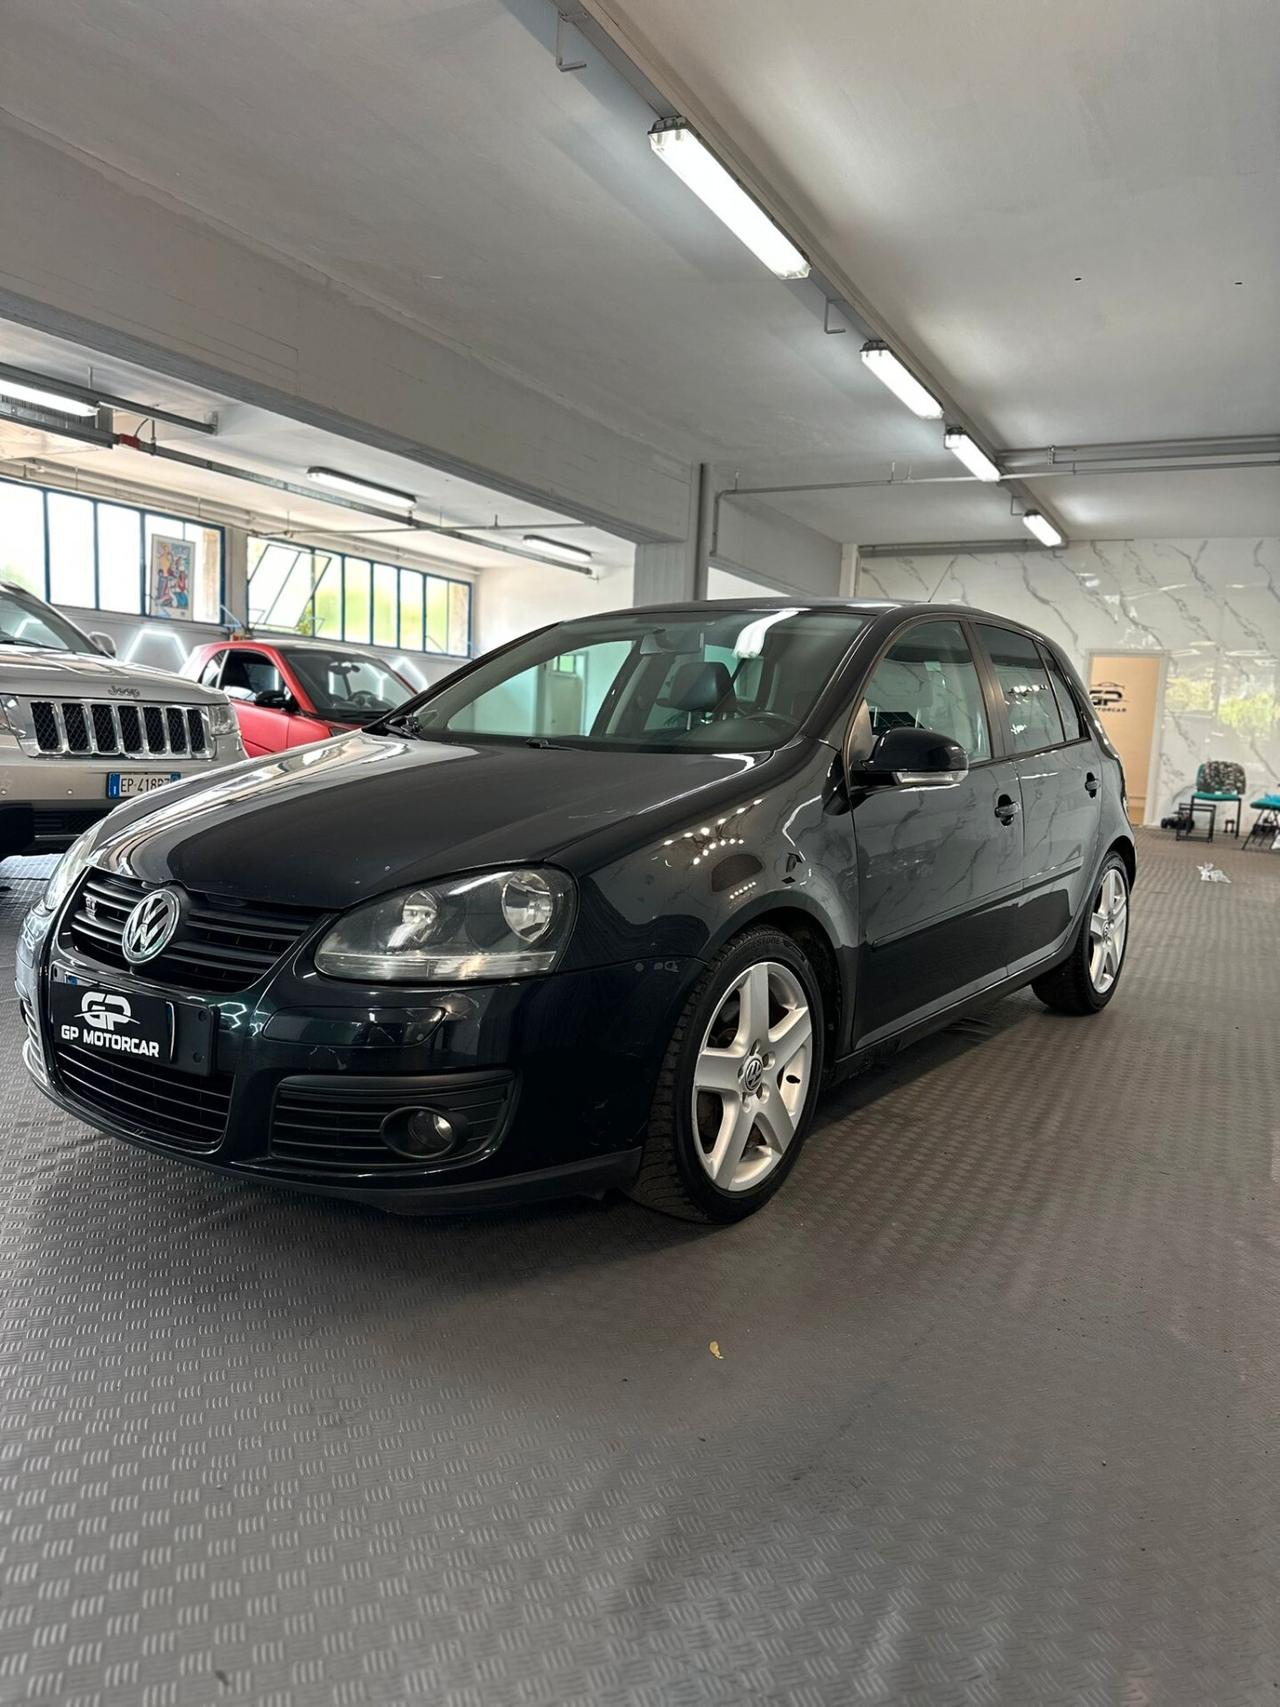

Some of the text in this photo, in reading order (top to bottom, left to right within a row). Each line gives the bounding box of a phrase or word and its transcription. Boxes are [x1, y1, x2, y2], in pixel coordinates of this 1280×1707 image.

[108, 685, 140, 698] Jeep
[81, 991, 132, 1030] GP
[61, 1025, 160, 1058] GP MOTORCAR
